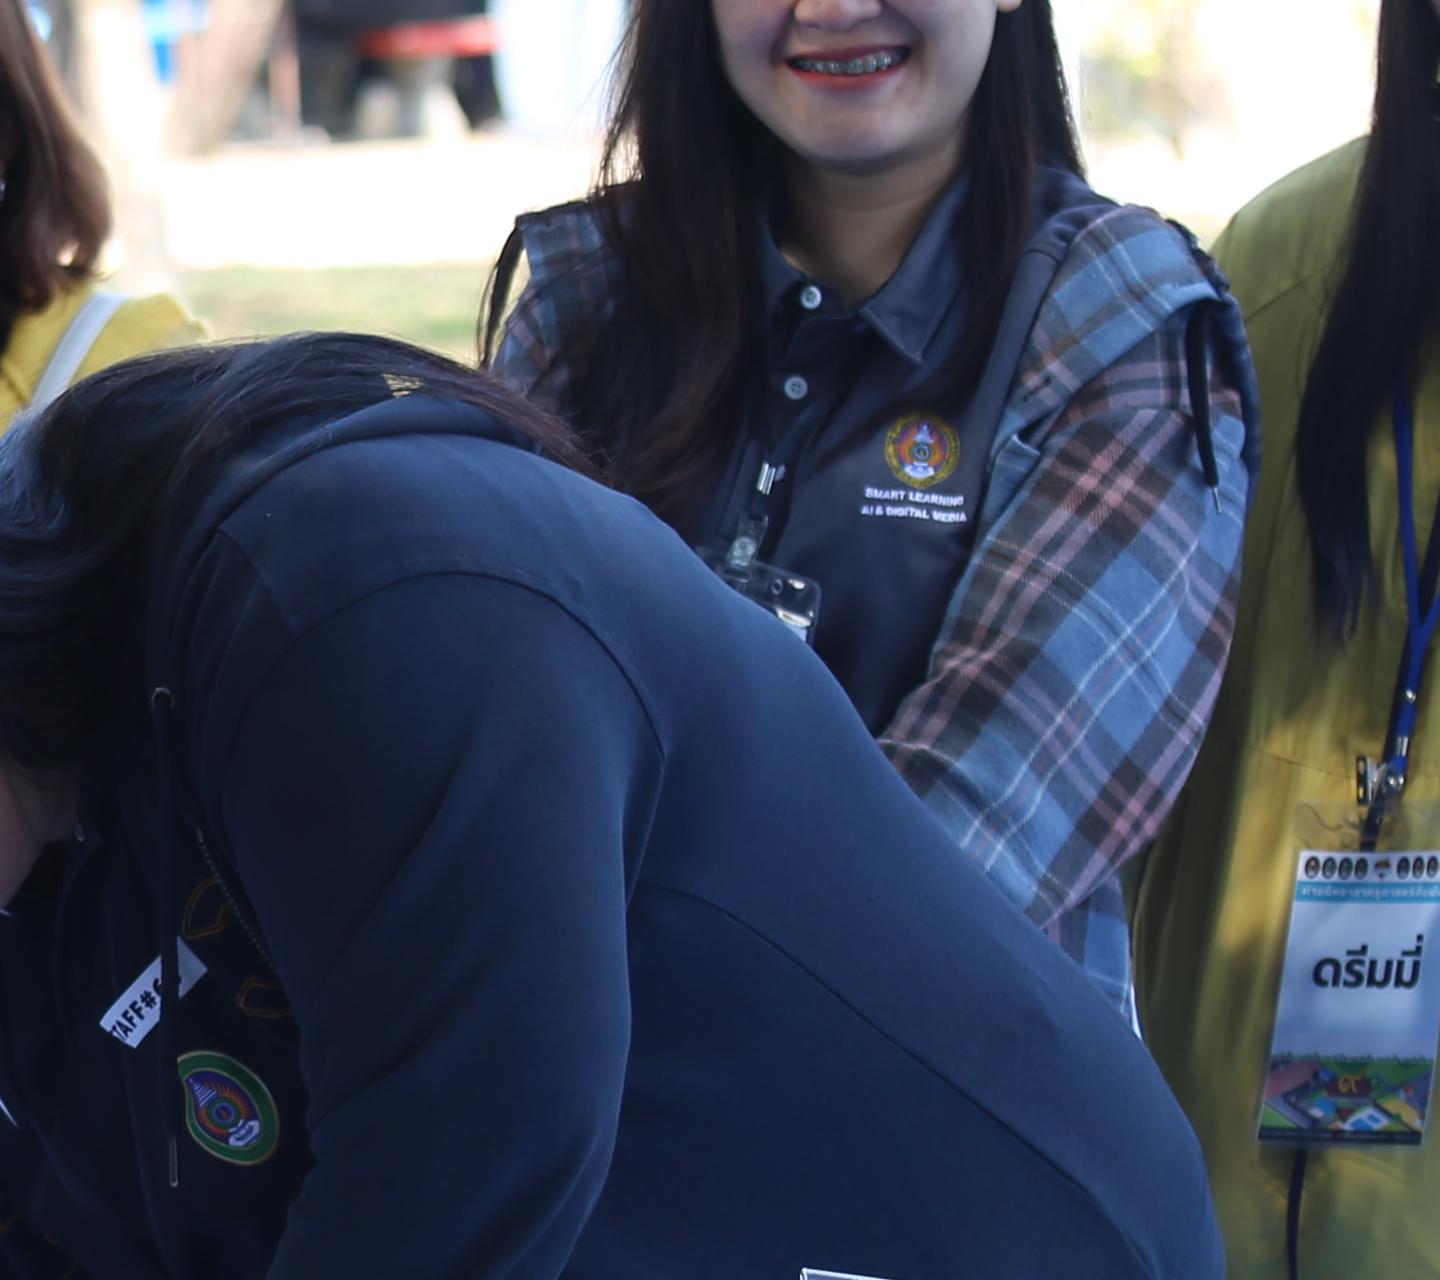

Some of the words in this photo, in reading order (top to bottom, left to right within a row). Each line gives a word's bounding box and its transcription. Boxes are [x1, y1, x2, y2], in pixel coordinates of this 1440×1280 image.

[864, 486, 906, 501] SMART
[908, 491, 965, 507] LEARNING
[886, 506, 930, 520] DIGITAL
[932, 509, 967, 523] MEDIA
[1312, 933, 1424, 989] ดรีมมี่
